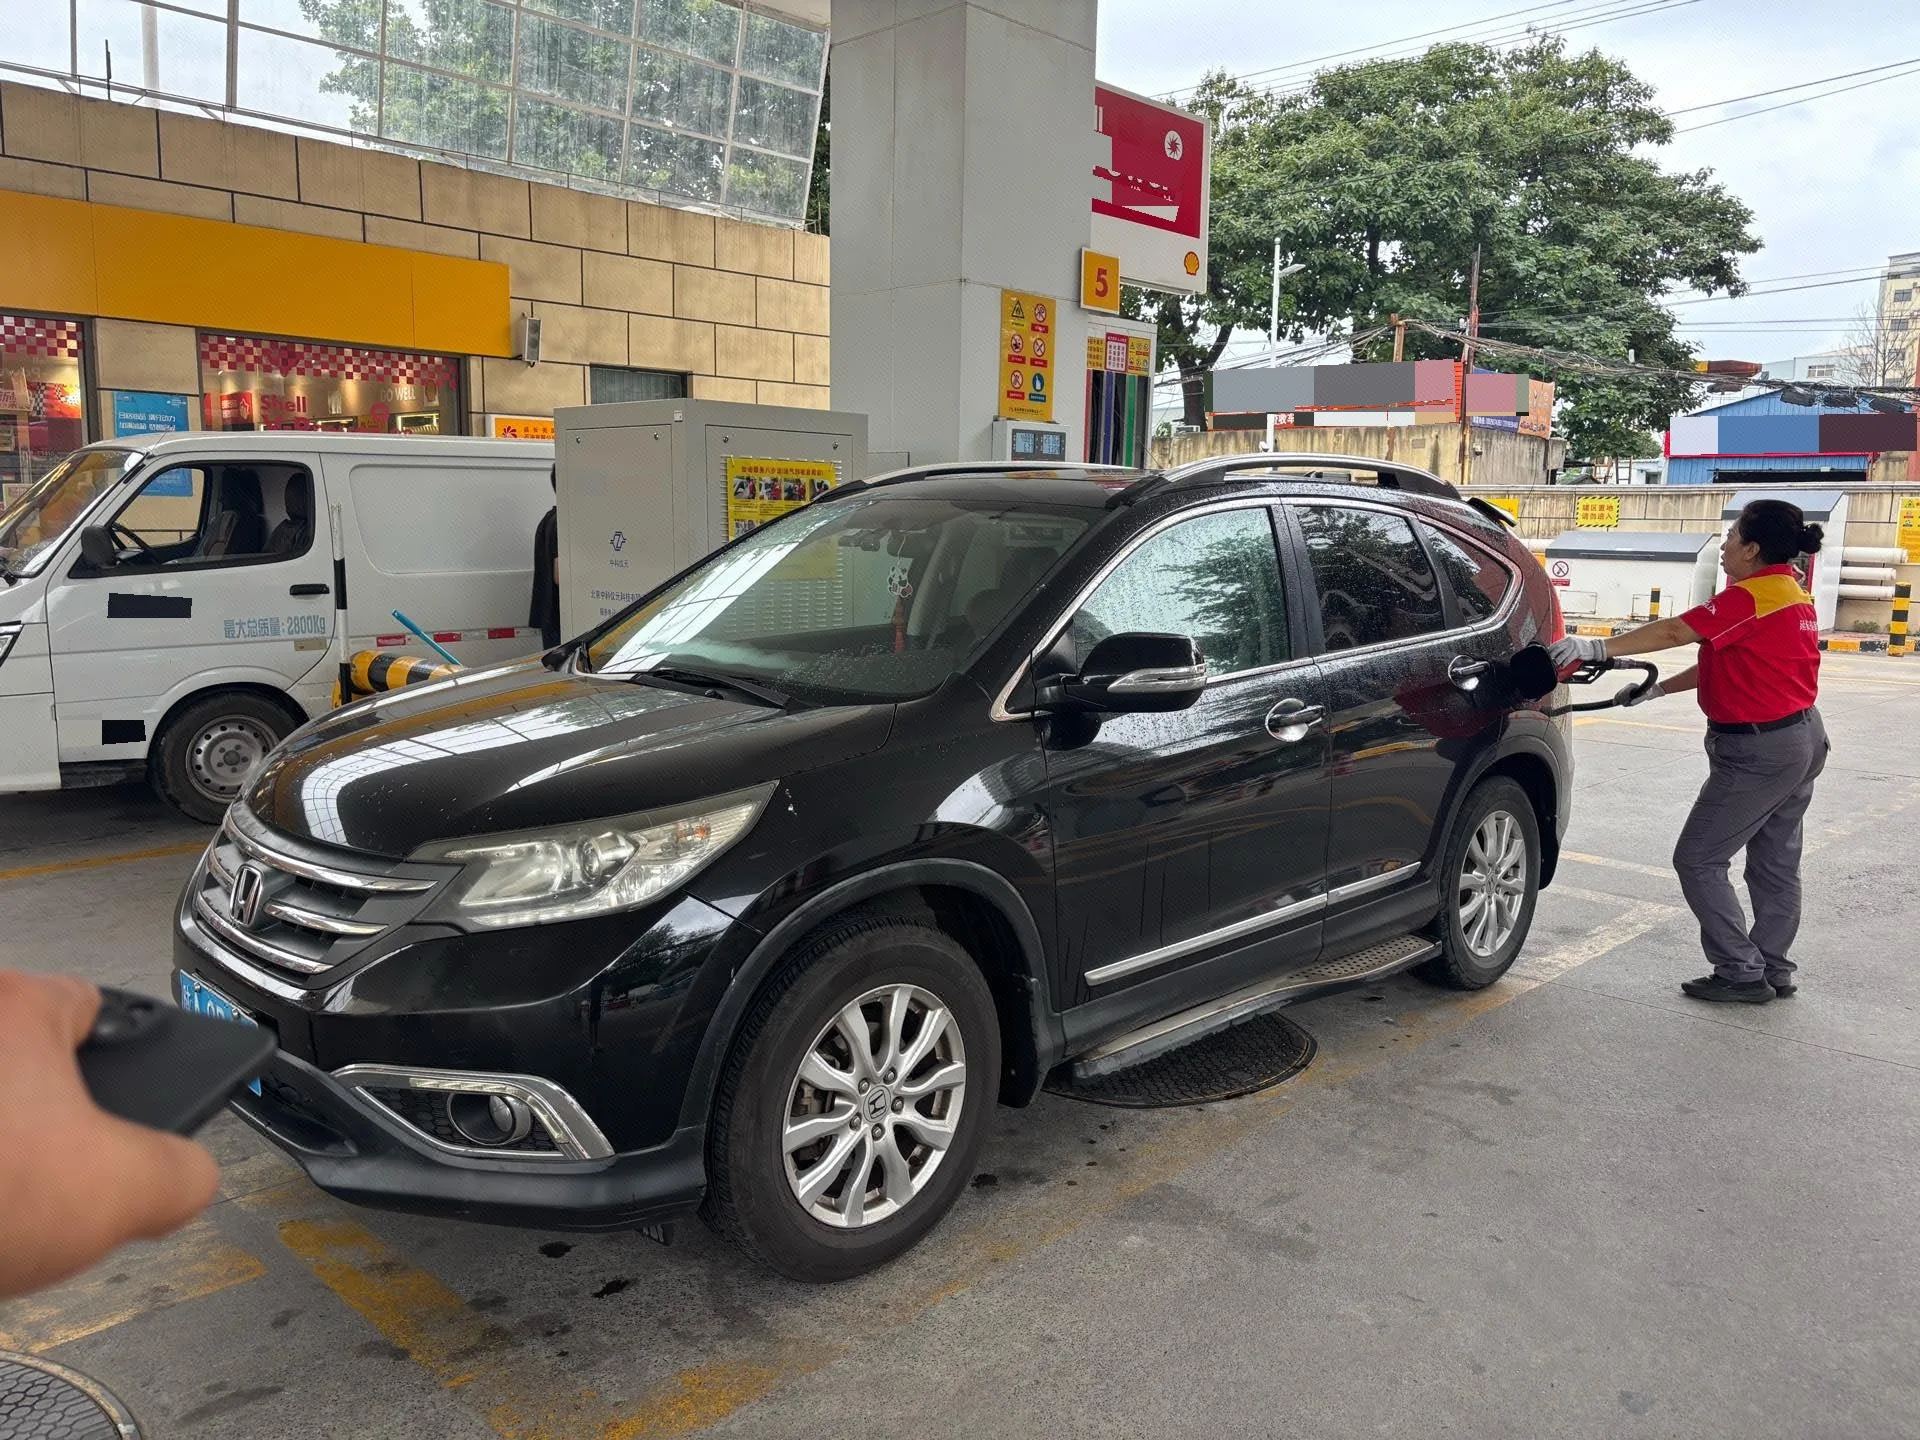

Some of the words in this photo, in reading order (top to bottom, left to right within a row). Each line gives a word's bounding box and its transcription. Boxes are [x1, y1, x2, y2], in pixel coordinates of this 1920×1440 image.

[1095, 268, 1109, 297] 5
[394, 385, 416, 401] WELL
[261, 394, 307, 413] Shell
[1582, 512, 1613, 520] 请勿进入
